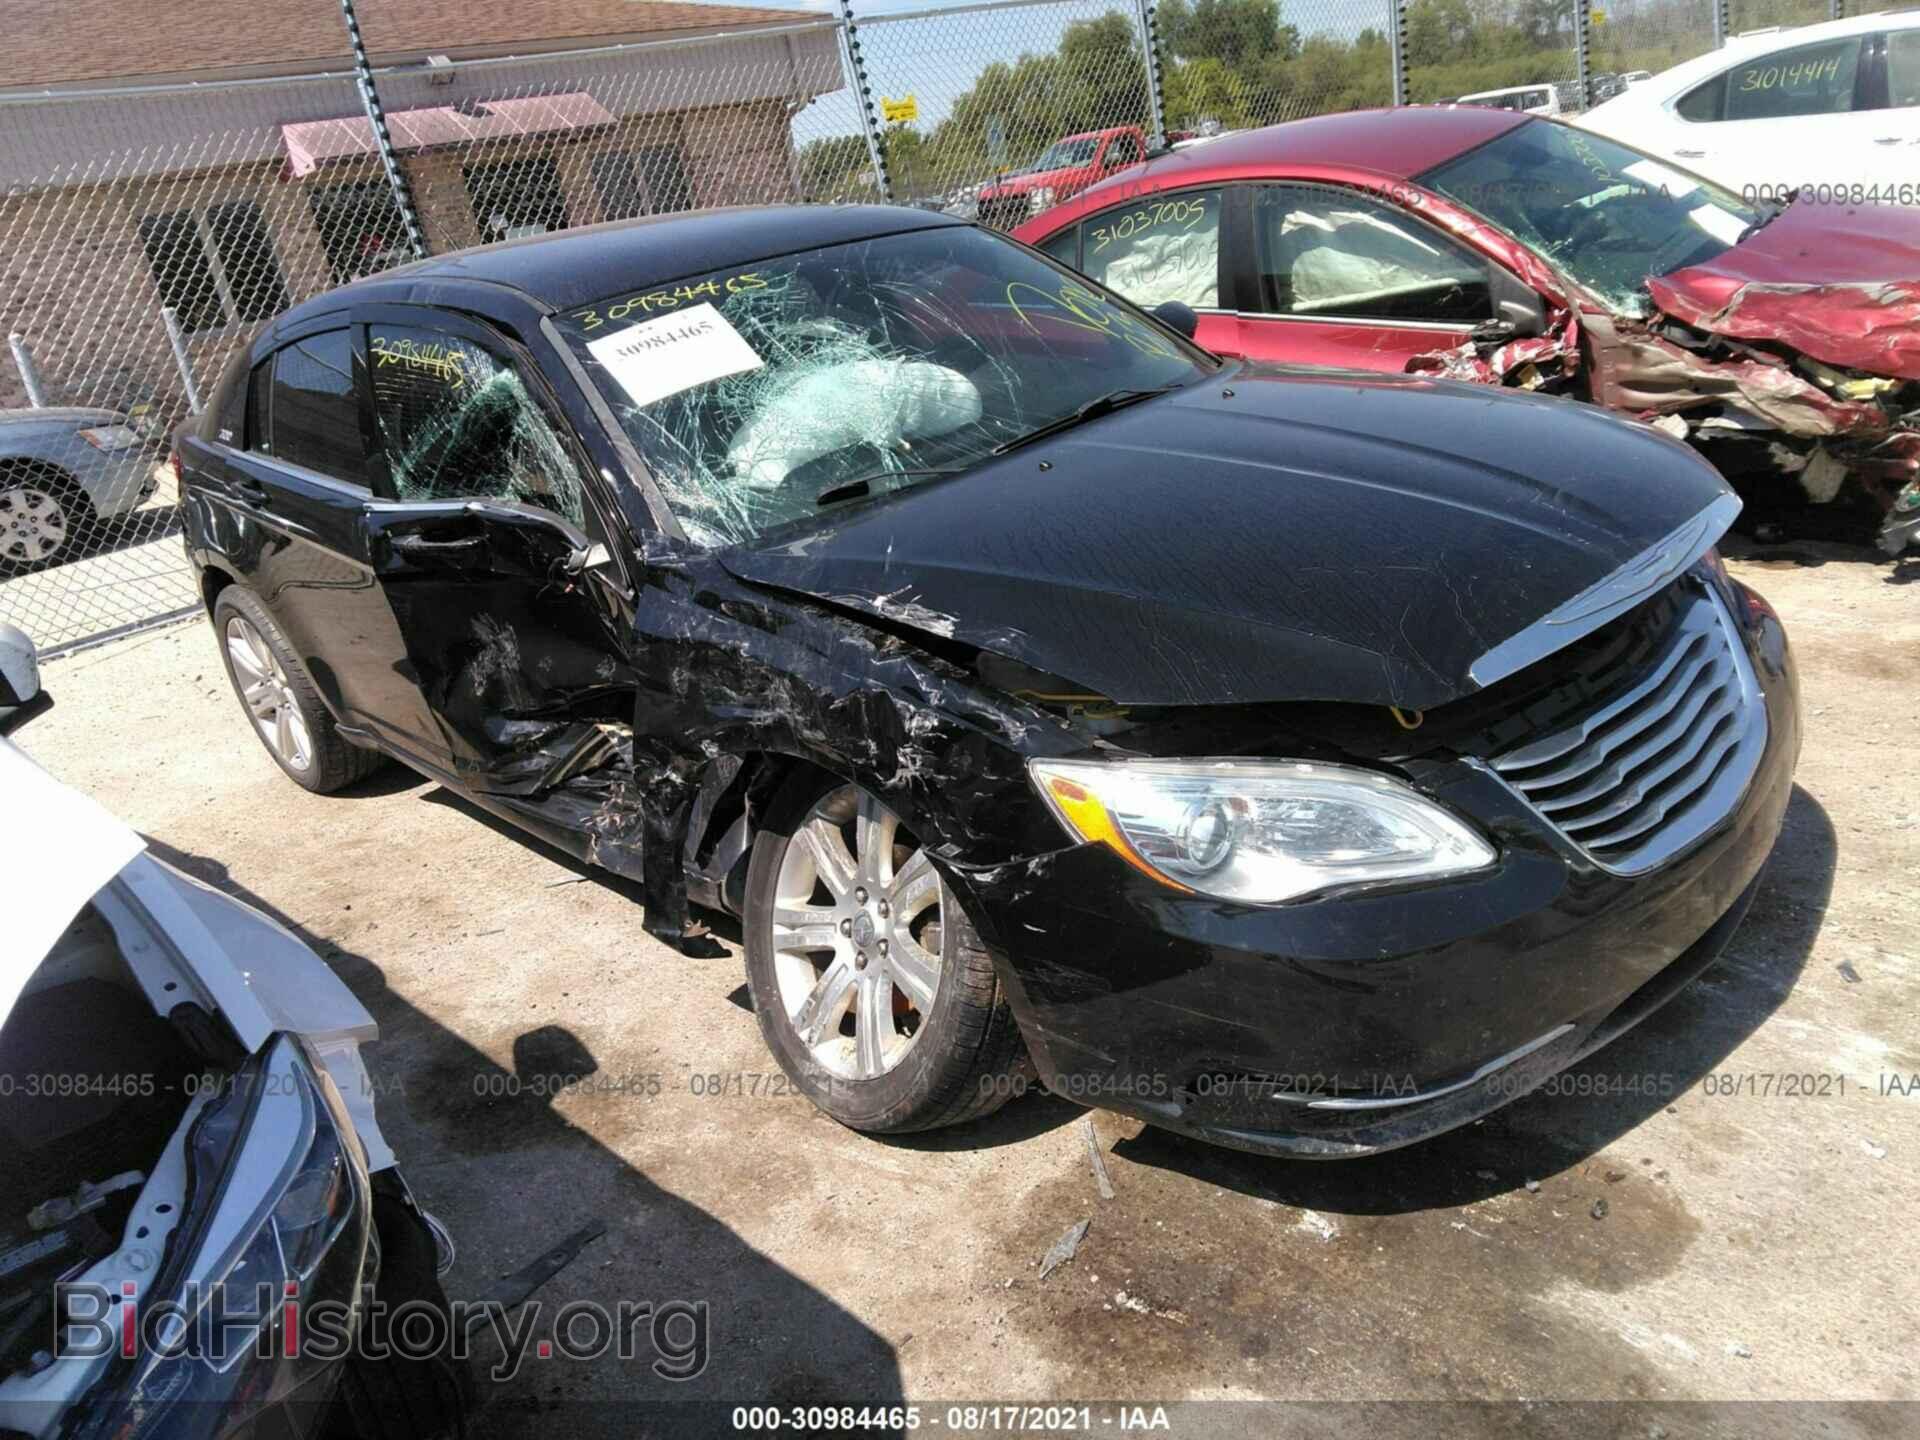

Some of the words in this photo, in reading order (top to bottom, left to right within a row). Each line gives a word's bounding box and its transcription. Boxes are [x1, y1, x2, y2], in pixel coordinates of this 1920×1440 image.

[1740, 56, 1842, 92] 31014414
[1091, 198, 1206, 254] 31037005
[571, 272, 768, 331] 30984465
